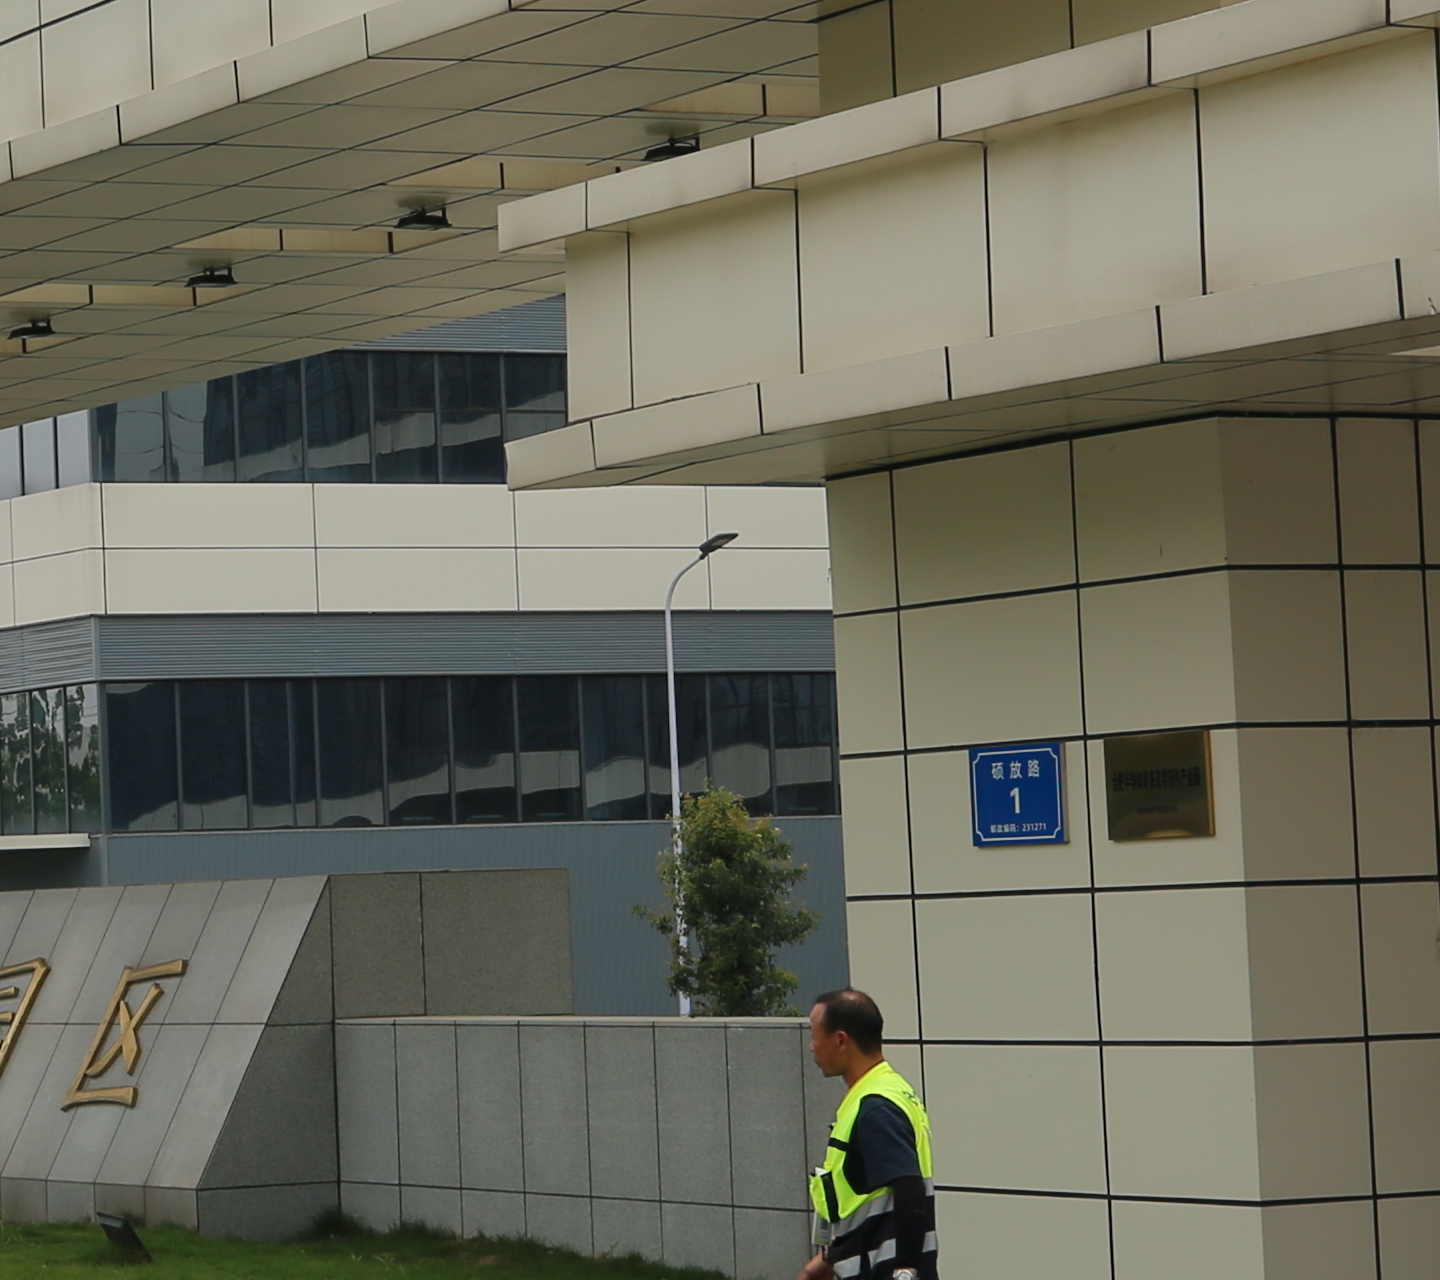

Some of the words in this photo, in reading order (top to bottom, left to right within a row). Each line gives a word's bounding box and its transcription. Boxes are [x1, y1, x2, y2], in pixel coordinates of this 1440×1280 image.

[991, 759, 1040, 780] 硕放路
[1009, 787, 1021, 814] 1
